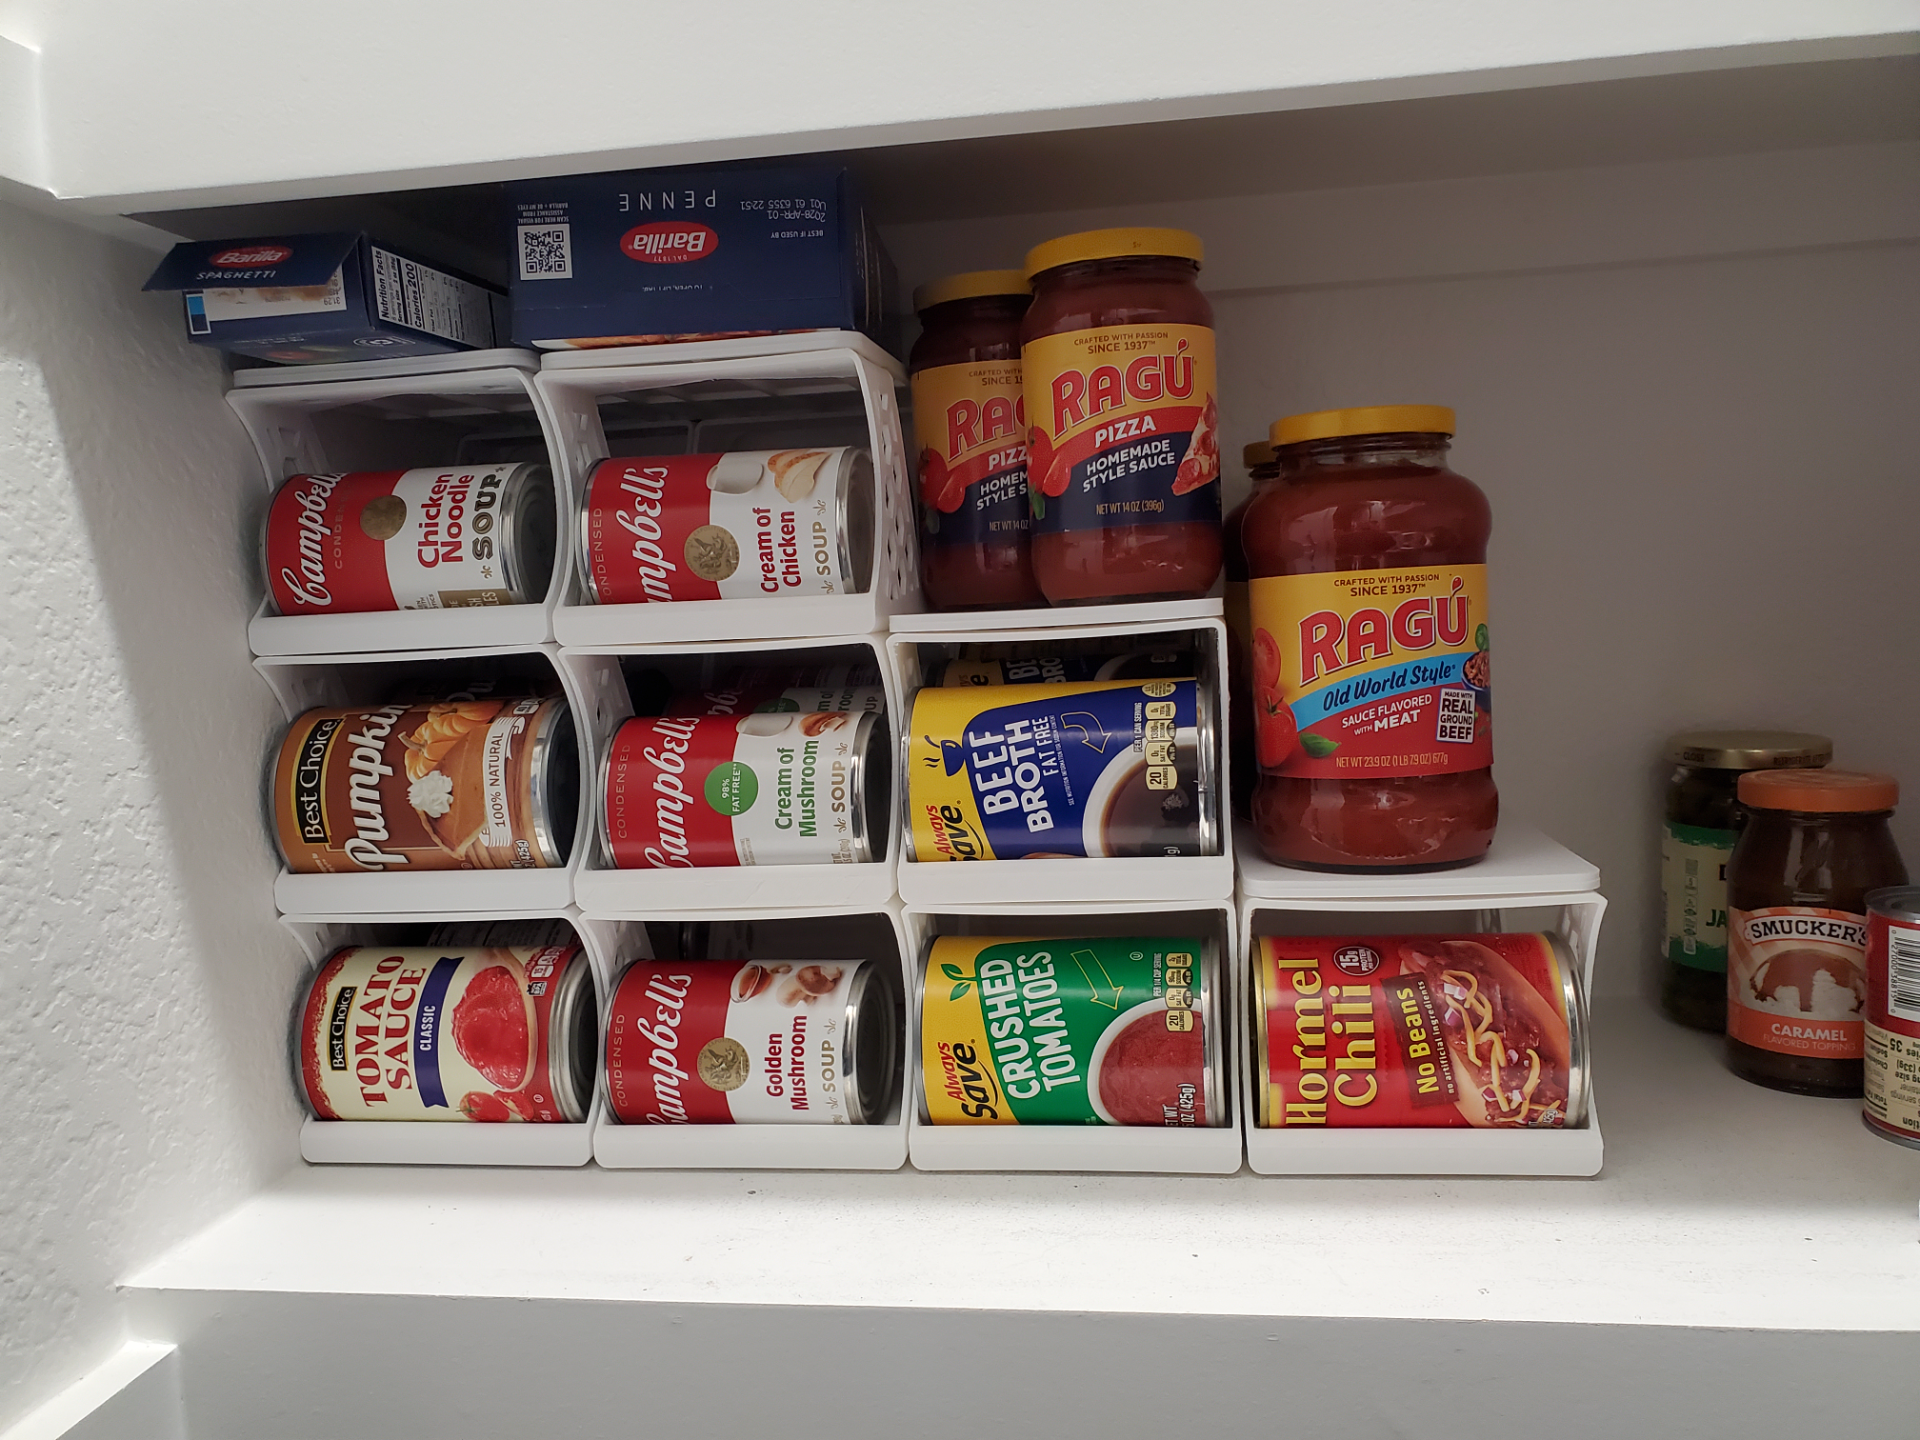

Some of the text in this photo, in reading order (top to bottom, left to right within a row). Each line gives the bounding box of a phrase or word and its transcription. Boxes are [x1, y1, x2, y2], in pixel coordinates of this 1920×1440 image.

[619, 189, 716, 212] PENNE
[766, 209, 826, 222] 2028-APR-01
[767, 198, 792, 211] 6355
[517, 217, 534, 225] VISUAL
[770, 229, 824, 239] BEST IF USED BY
[216, 249, 285, 265] Barilla
[632, 231, 707, 255] Barilla
[196, 269, 277, 281] SPAGHETTI
[374, 249, 390, 320] Nutrition Facts
[405, 262, 422, 328] Calories 200
[1074, 331, 1169, 346] CRAFTED WITH PASSION
[1087, 342, 1121, 354] SINCE
[968, 367, 1022, 377] CRAFTED WITH
[981, 375, 1013, 386] SINCE
[946, 396, 1025, 463] RA
[1094, 416, 1157, 448] PIZZA
[988, 446, 1027, 471] PIZZ
[1082, 452, 1176, 494] STYLE SAUCE
[1086, 439, 1171, 477] HOMEMADE
[976, 488, 1017, 511] STYLE
[980, 471, 1028, 496] HOMEM
[417, 473, 453, 569] Chicken
[441, 474, 475, 563] Noodle
[471, 474, 503, 561] SOUP
[1096, 500, 1165, 516] NET WT 14 OZ (396g)
[281, 472, 349, 607] Campbell
[615, 465, 677, 603] mpbell's
[989, 521, 1013, 532] NET WT
[752, 507, 780, 593] Cream of
[778, 510, 802, 588] Chicken
[812, 521, 831, 576] SOUP
[1333, 573, 1440, 587] CRAFTED WITH PASSION
[1349, 584, 1388, 597] SINCE
[1322, 663, 1456, 713] Old World Style
[1444, 690, 1473, 700] MADE WITH
[1341, 693, 1433, 729] SAUCE FLAVORED
[1354, 708, 1423, 736] WITH MEAT
[1440, 713, 1473, 727] GROUND
[1441, 698, 1474, 715] REAL
[1133, 702, 1143, 752] PER CAN SERVING
[1438, 725, 1473, 741] BEEF
[1032, 715, 1060, 777] FAT FREE
[1335, 753, 1448, 768] NET WT 23.9 OZ LB OZ) 677g
[1682, 751, 1706, 763] CLOSE
[344, 702, 413, 870] Pumpkin
[488, 732, 507, 828] 100% NATURAL
[721, 777, 731, 799] 98%
[775, 747, 795, 830] Cream of
[796, 740, 819, 837] Mushroom
[830, 760, 846, 813] SOUP
[968, 731, 1020, 815] BEEF
[1006, 719, 1055, 833] BROTH
[1058, 751, 1073, 797] NUTRITION INFORMATION
[1150, 772, 1162, 785] 20
[614, 744, 631, 839] CONDENSED
[731, 795, 741, 812] FAT
[304, 793, 325, 839] Best
[925, 804, 950, 855] Always
[941, 805, 979, 861] ave
[1750, 919, 1867, 946] SMUCKER'S
[1154, 953, 1162, 996] PER CUP SERVING
[1339, 950, 1360, 969] 15g
[1358, 948, 1369, 972] PROTEIN
[354, 955, 405, 1108] TOMATO
[383, 967, 427, 1091] SAUCE
[419, 1004, 436, 1051] CLASSIC
[979, 959, 1041, 1099] CRUSHED
[1016, 951, 1081, 1092] TOMATOES
[1168, 1015, 1179, 1026] 20
[1416, 980, 1455, 1094] no artificial ingredients
[1771, 1022, 1848, 1043] CARAMEL
[332, 1037, 347, 1069] Best
[1278, 957, 1328, 1125] Hormel
[1331, 984, 1378, 1107] Chili
[1395, 987, 1440, 1094] No Beans
[1762, 1034, 1857, 1053] FLAVORED TOPPING
[1889, 1037, 1903, 1053] 35
[614, 1014, 628, 1107] CONDENSED
[764, 1033, 784, 1098] Golden
[787, 1015, 810, 1111] Mushroom
[820, 1040, 836, 1093] SOUP
[937, 1041, 967, 1102] Always
[1894, 1070, 1911, 1081] size
[1896, 1058, 1916, 1073] (33g)
[952, 1042, 998, 1119] Save
[1177, 1083, 1196, 1112] (425g)
[1889, 1089, 1917, 1105] servings
[1161, 1103, 1178, 1118] WT
[1874, 1093, 1888, 1106] Total
[1180, 1113, 1195, 1123] OZ
